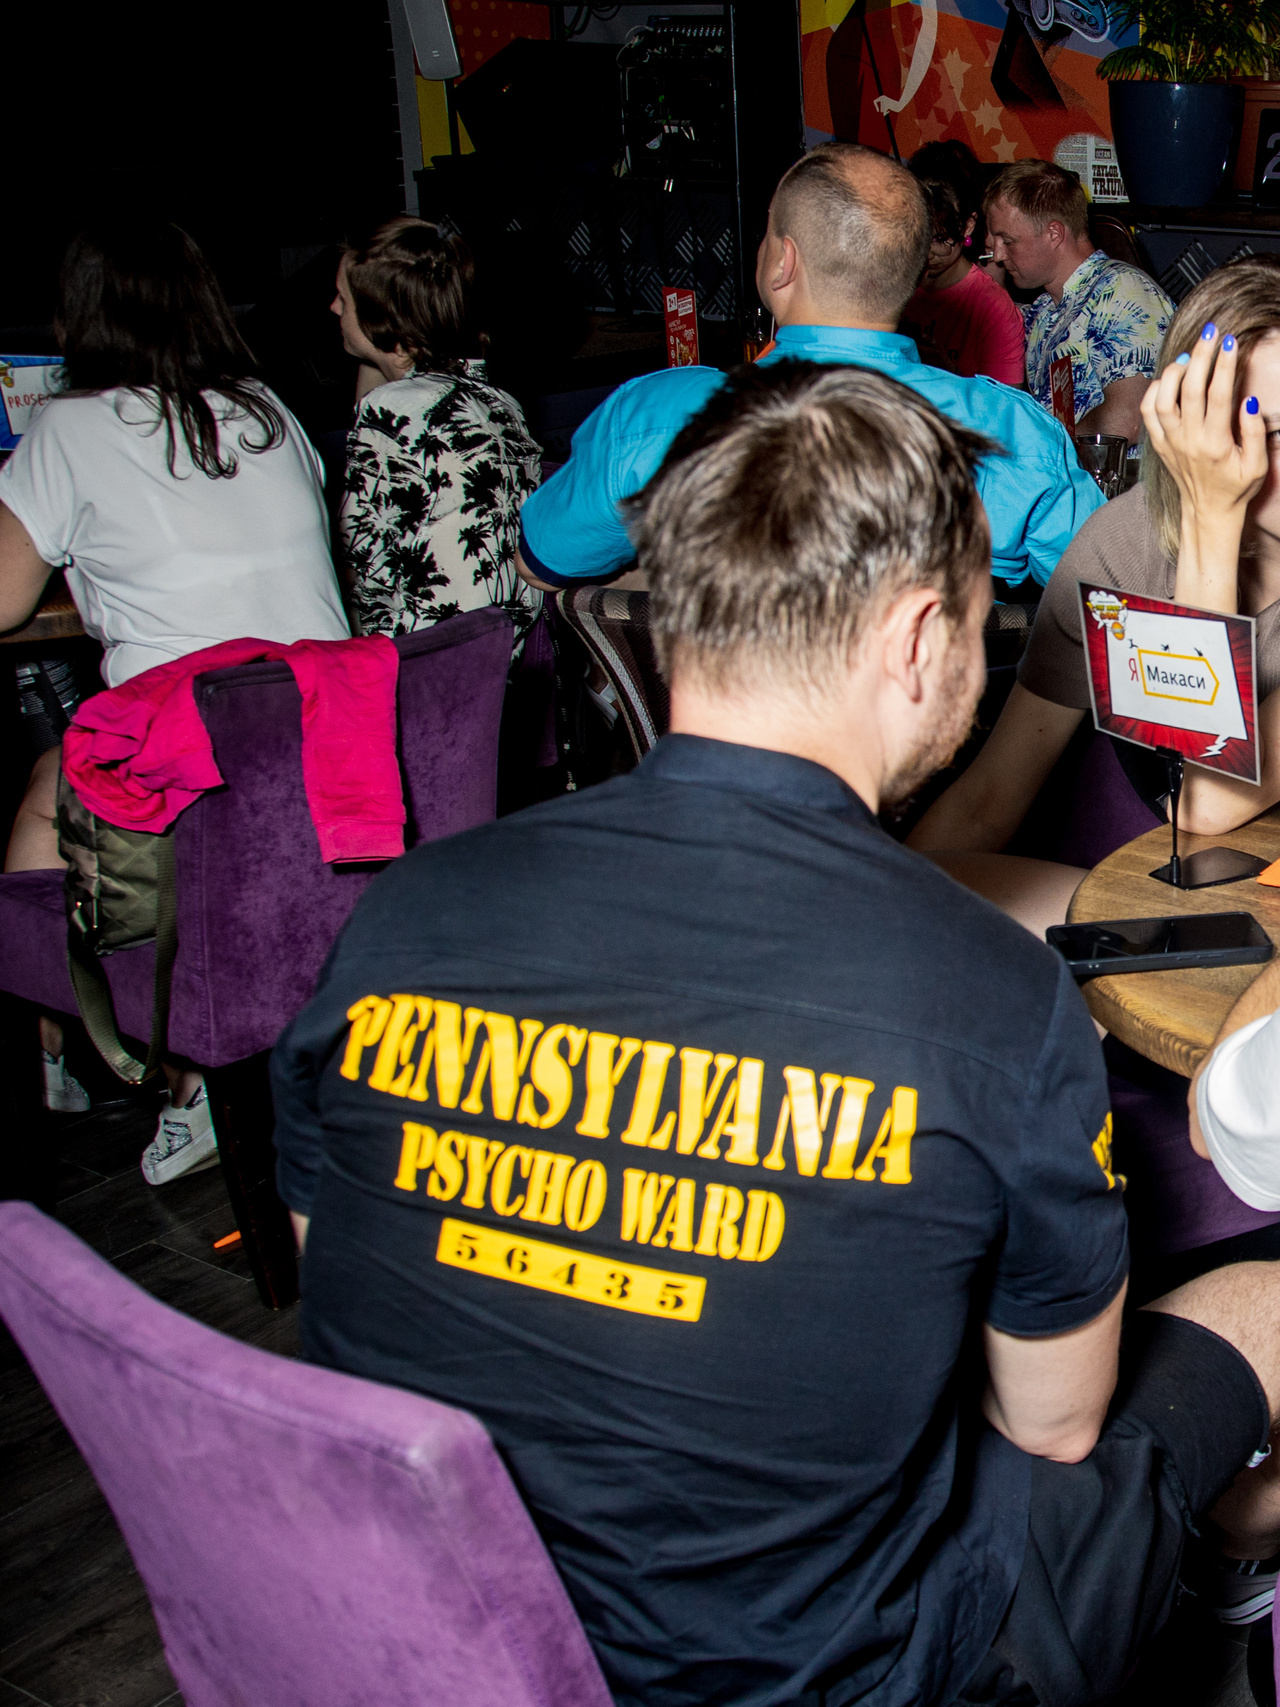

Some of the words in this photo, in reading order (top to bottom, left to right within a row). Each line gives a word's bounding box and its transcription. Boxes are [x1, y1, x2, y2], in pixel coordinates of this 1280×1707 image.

[1092, 165, 1118, 177] TAYLOR
[1146, 664, 1207, 690] Макаси
[339, 993, 918, 1185] PENNSYLVANIA
[394, 1122, 608, 1233] PSYCHO
[619, 1167, 786, 1264] WARD
